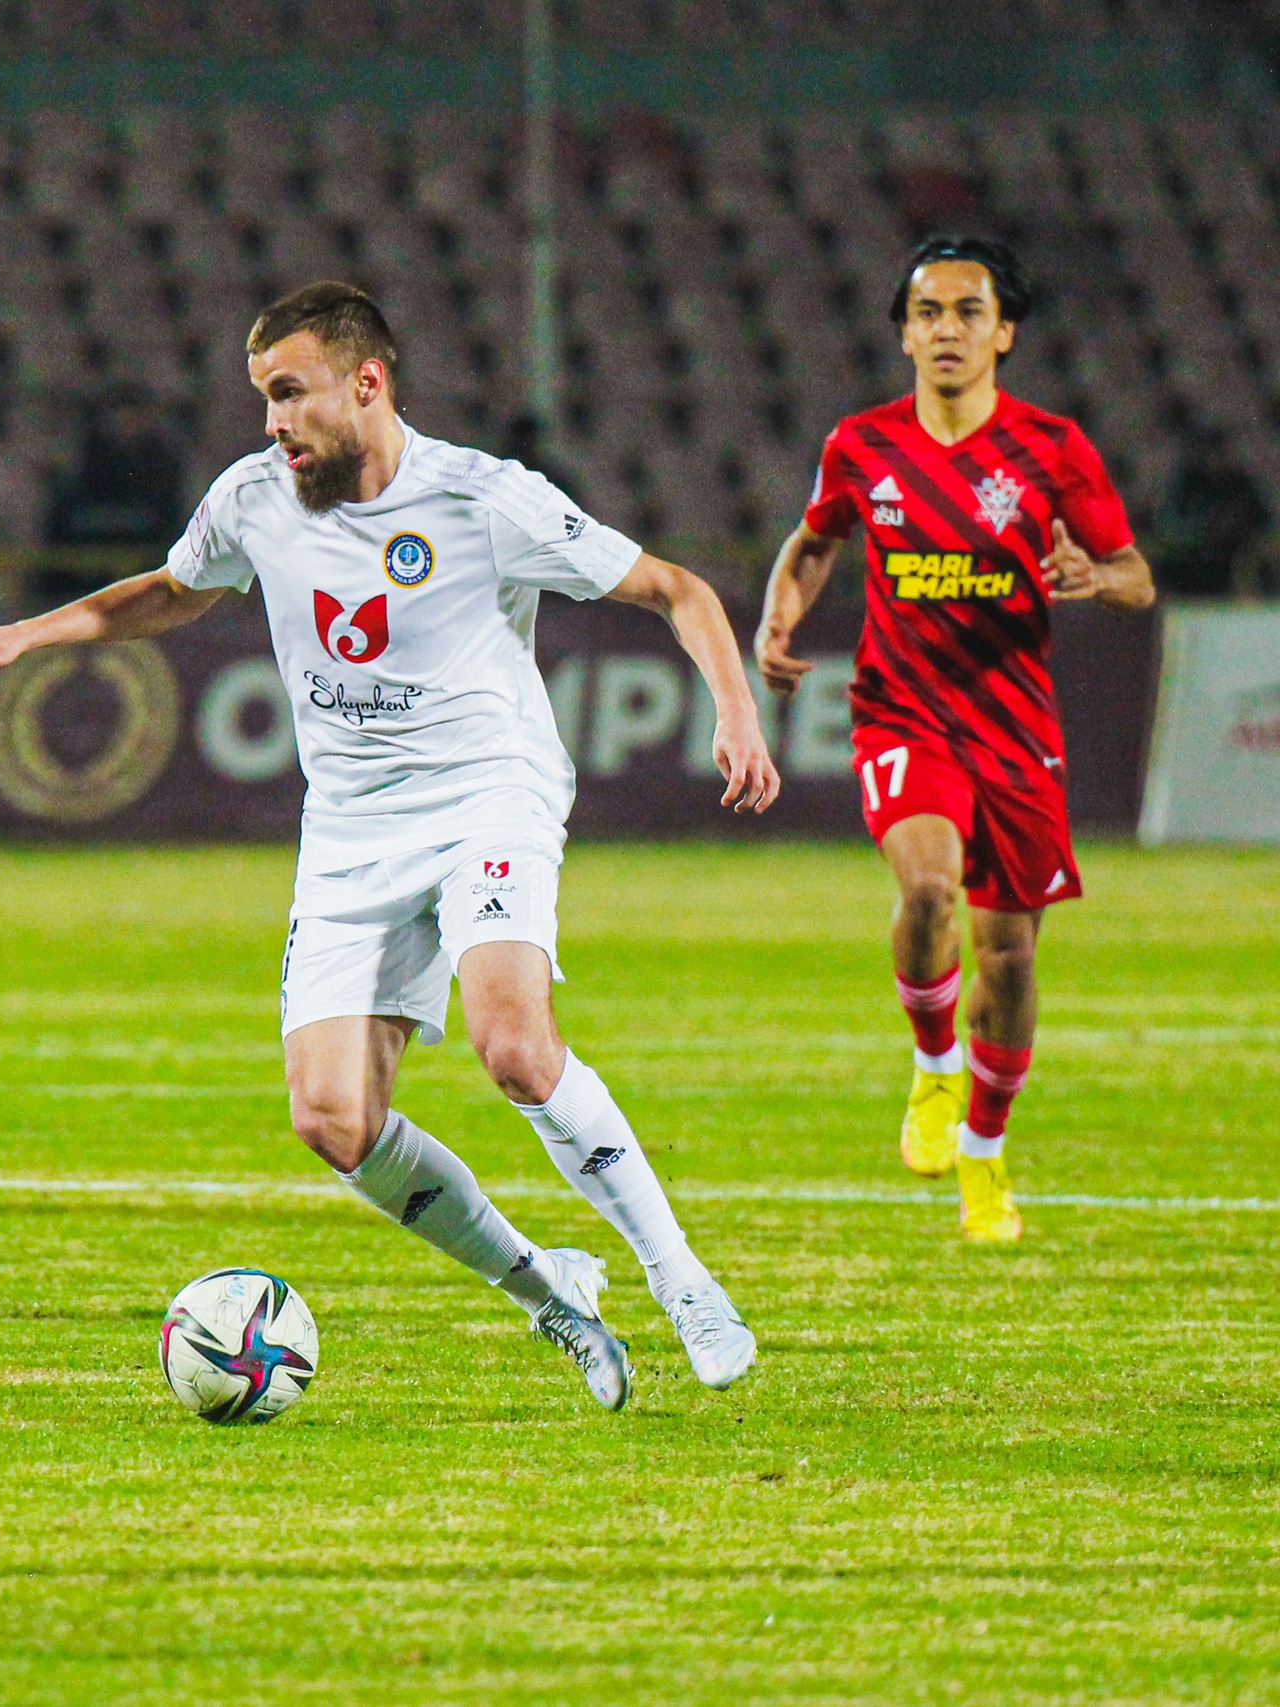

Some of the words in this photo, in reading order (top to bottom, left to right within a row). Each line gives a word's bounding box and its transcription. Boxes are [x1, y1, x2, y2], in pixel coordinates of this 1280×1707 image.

[886, 553, 974, 577] PARI
[897, 571, 1015, 600] MATCH
[304, 670, 423, 727] Shymkent
[862, 745, 910, 812] 17
[472, 911, 511, 923] adidas
